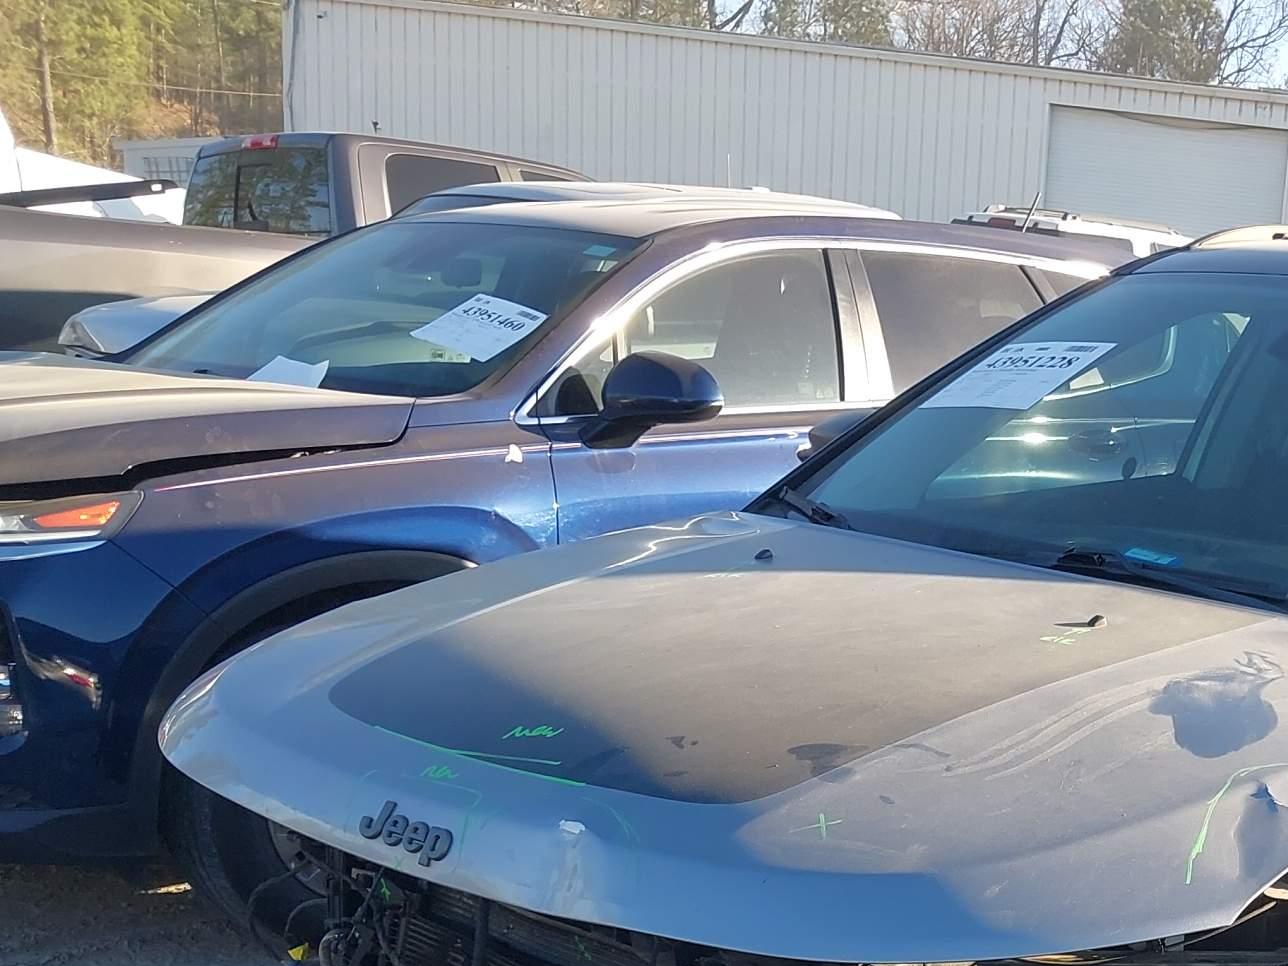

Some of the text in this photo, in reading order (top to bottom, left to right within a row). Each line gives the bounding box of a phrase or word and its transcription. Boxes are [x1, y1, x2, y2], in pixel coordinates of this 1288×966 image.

[461, 306, 526, 332] 43951460
[986, 355, 1081, 370] 43951228
[359, 800, 454, 867] Jeep
